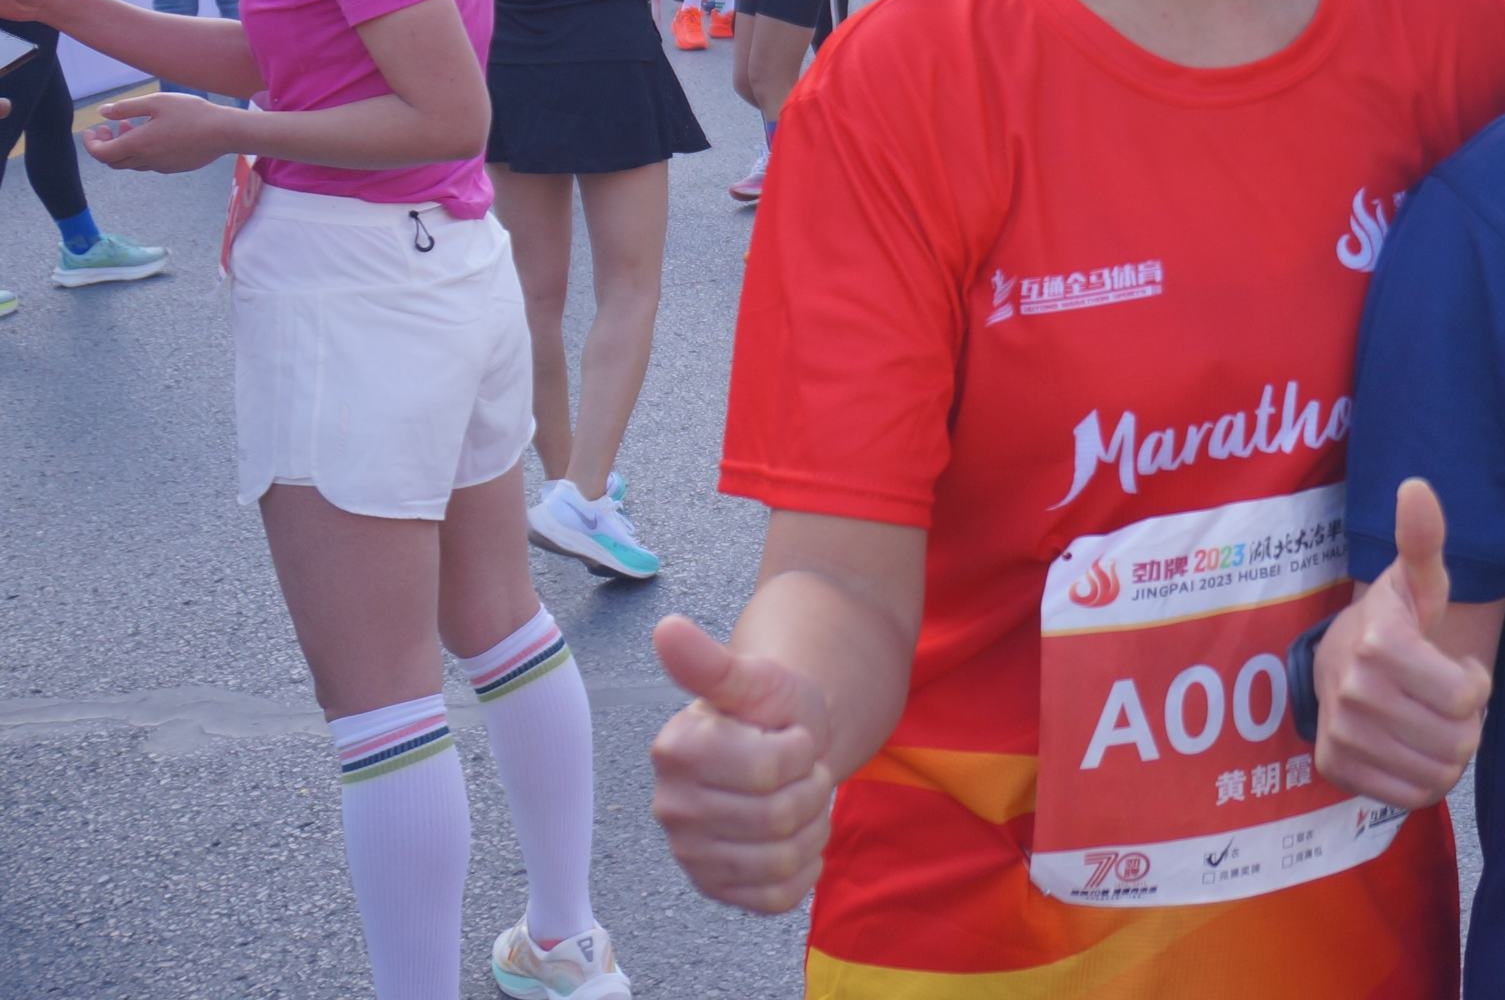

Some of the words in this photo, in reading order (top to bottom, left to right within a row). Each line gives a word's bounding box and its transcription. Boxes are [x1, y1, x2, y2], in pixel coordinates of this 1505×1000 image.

[1131, 581, 1194, 602] JINGPAI
[1199, 573, 1232, 591] 2023
[1238, 565, 1281, 583] HUBEI
[1290, 555, 1320, 573] DAYE
[1132, 557, 1188, 584] 劲牌
[1193, 543, 1246, 573] 2023
[1215, 754, 1312, 807] 黄朝霞
